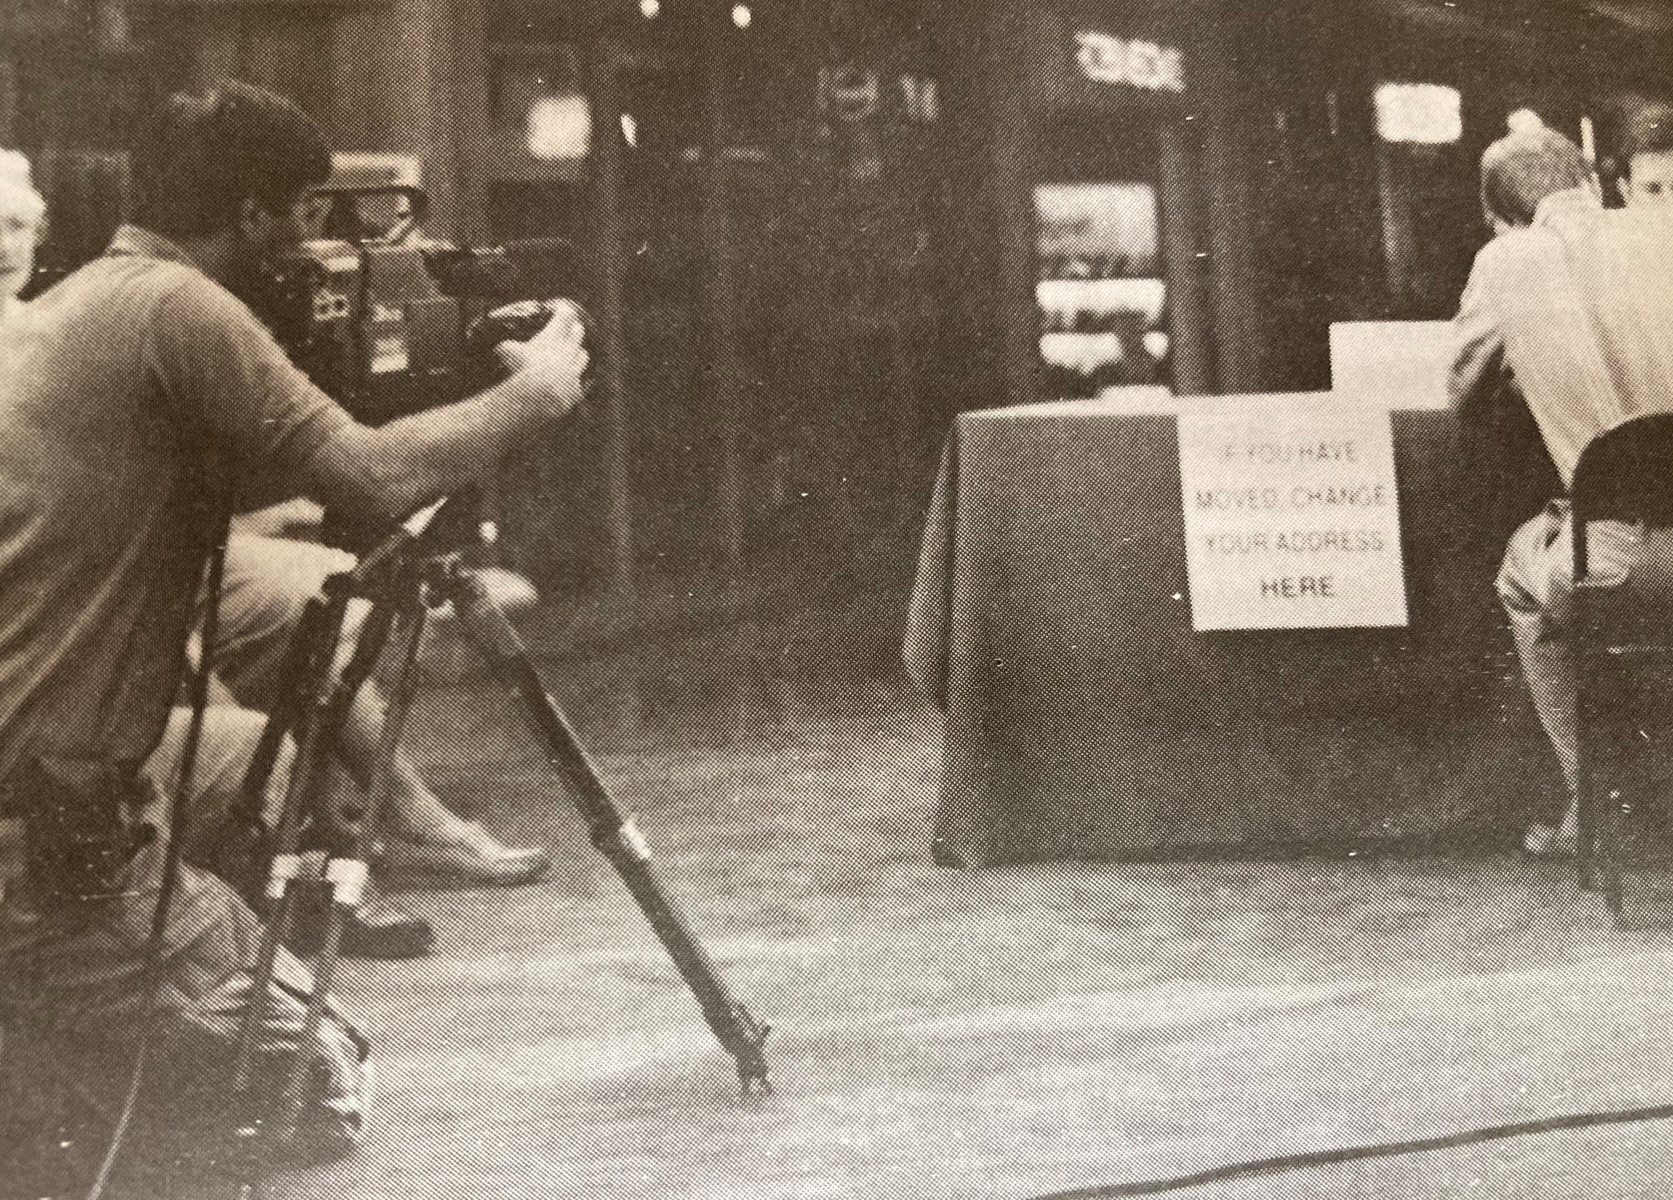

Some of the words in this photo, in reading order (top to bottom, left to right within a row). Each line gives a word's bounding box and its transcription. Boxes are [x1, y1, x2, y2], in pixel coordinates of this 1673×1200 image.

[1247, 443, 1292, 465] YOU
[1298, 440, 1359, 464] HAVE
[1290, 484, 1387, 509] CHANGE
[1206, 532, 1269, 555] YOUR
[1276, 530, 1385, 553] ADDRESS
[1260, 575, 1336, 599] HERE
